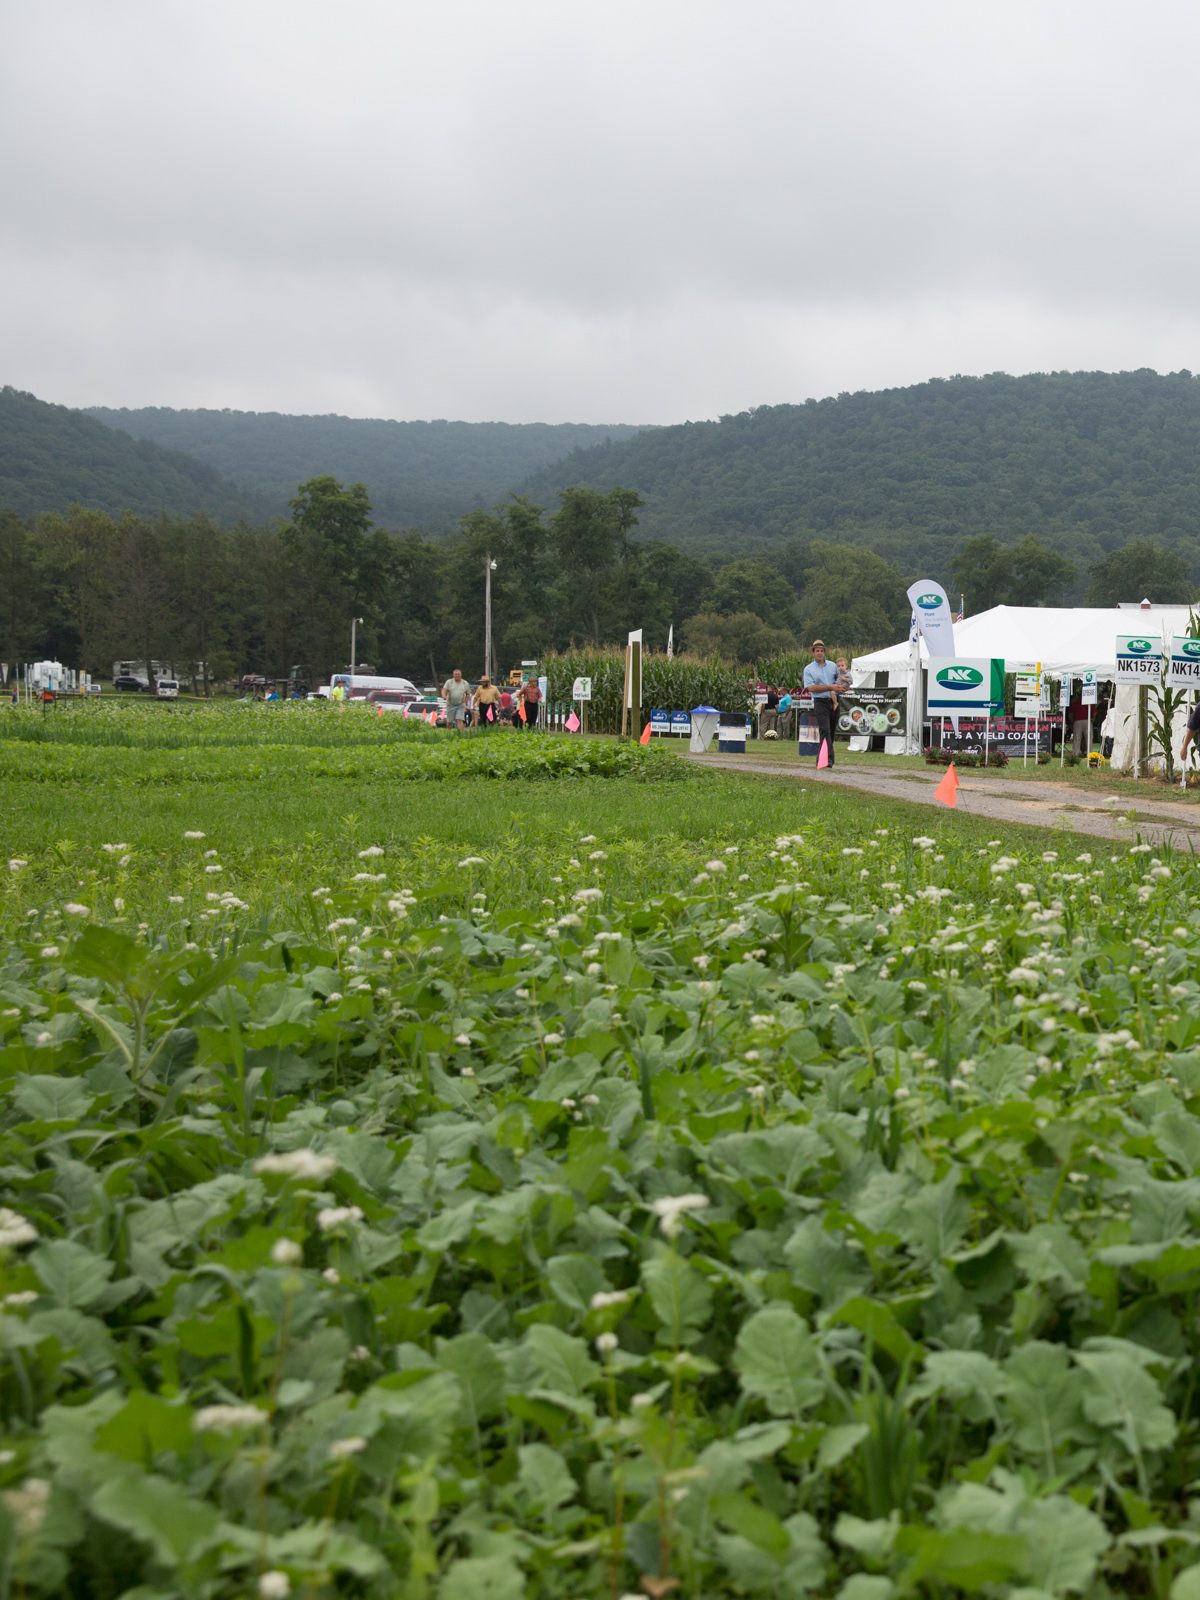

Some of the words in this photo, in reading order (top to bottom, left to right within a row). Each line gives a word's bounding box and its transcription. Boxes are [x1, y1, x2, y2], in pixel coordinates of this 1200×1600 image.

[923, 596, 937, 604] NK
[1118, 660, 1160, 672] NK1573
[947, 669, 973, 680] NK
[996, 723, 1049, 732] SALESMAN
[943, 732, 962, 740] IT'S
[976, 732, 1005, 740] YIELD
[1007, 732, 1040, 740] COACH
